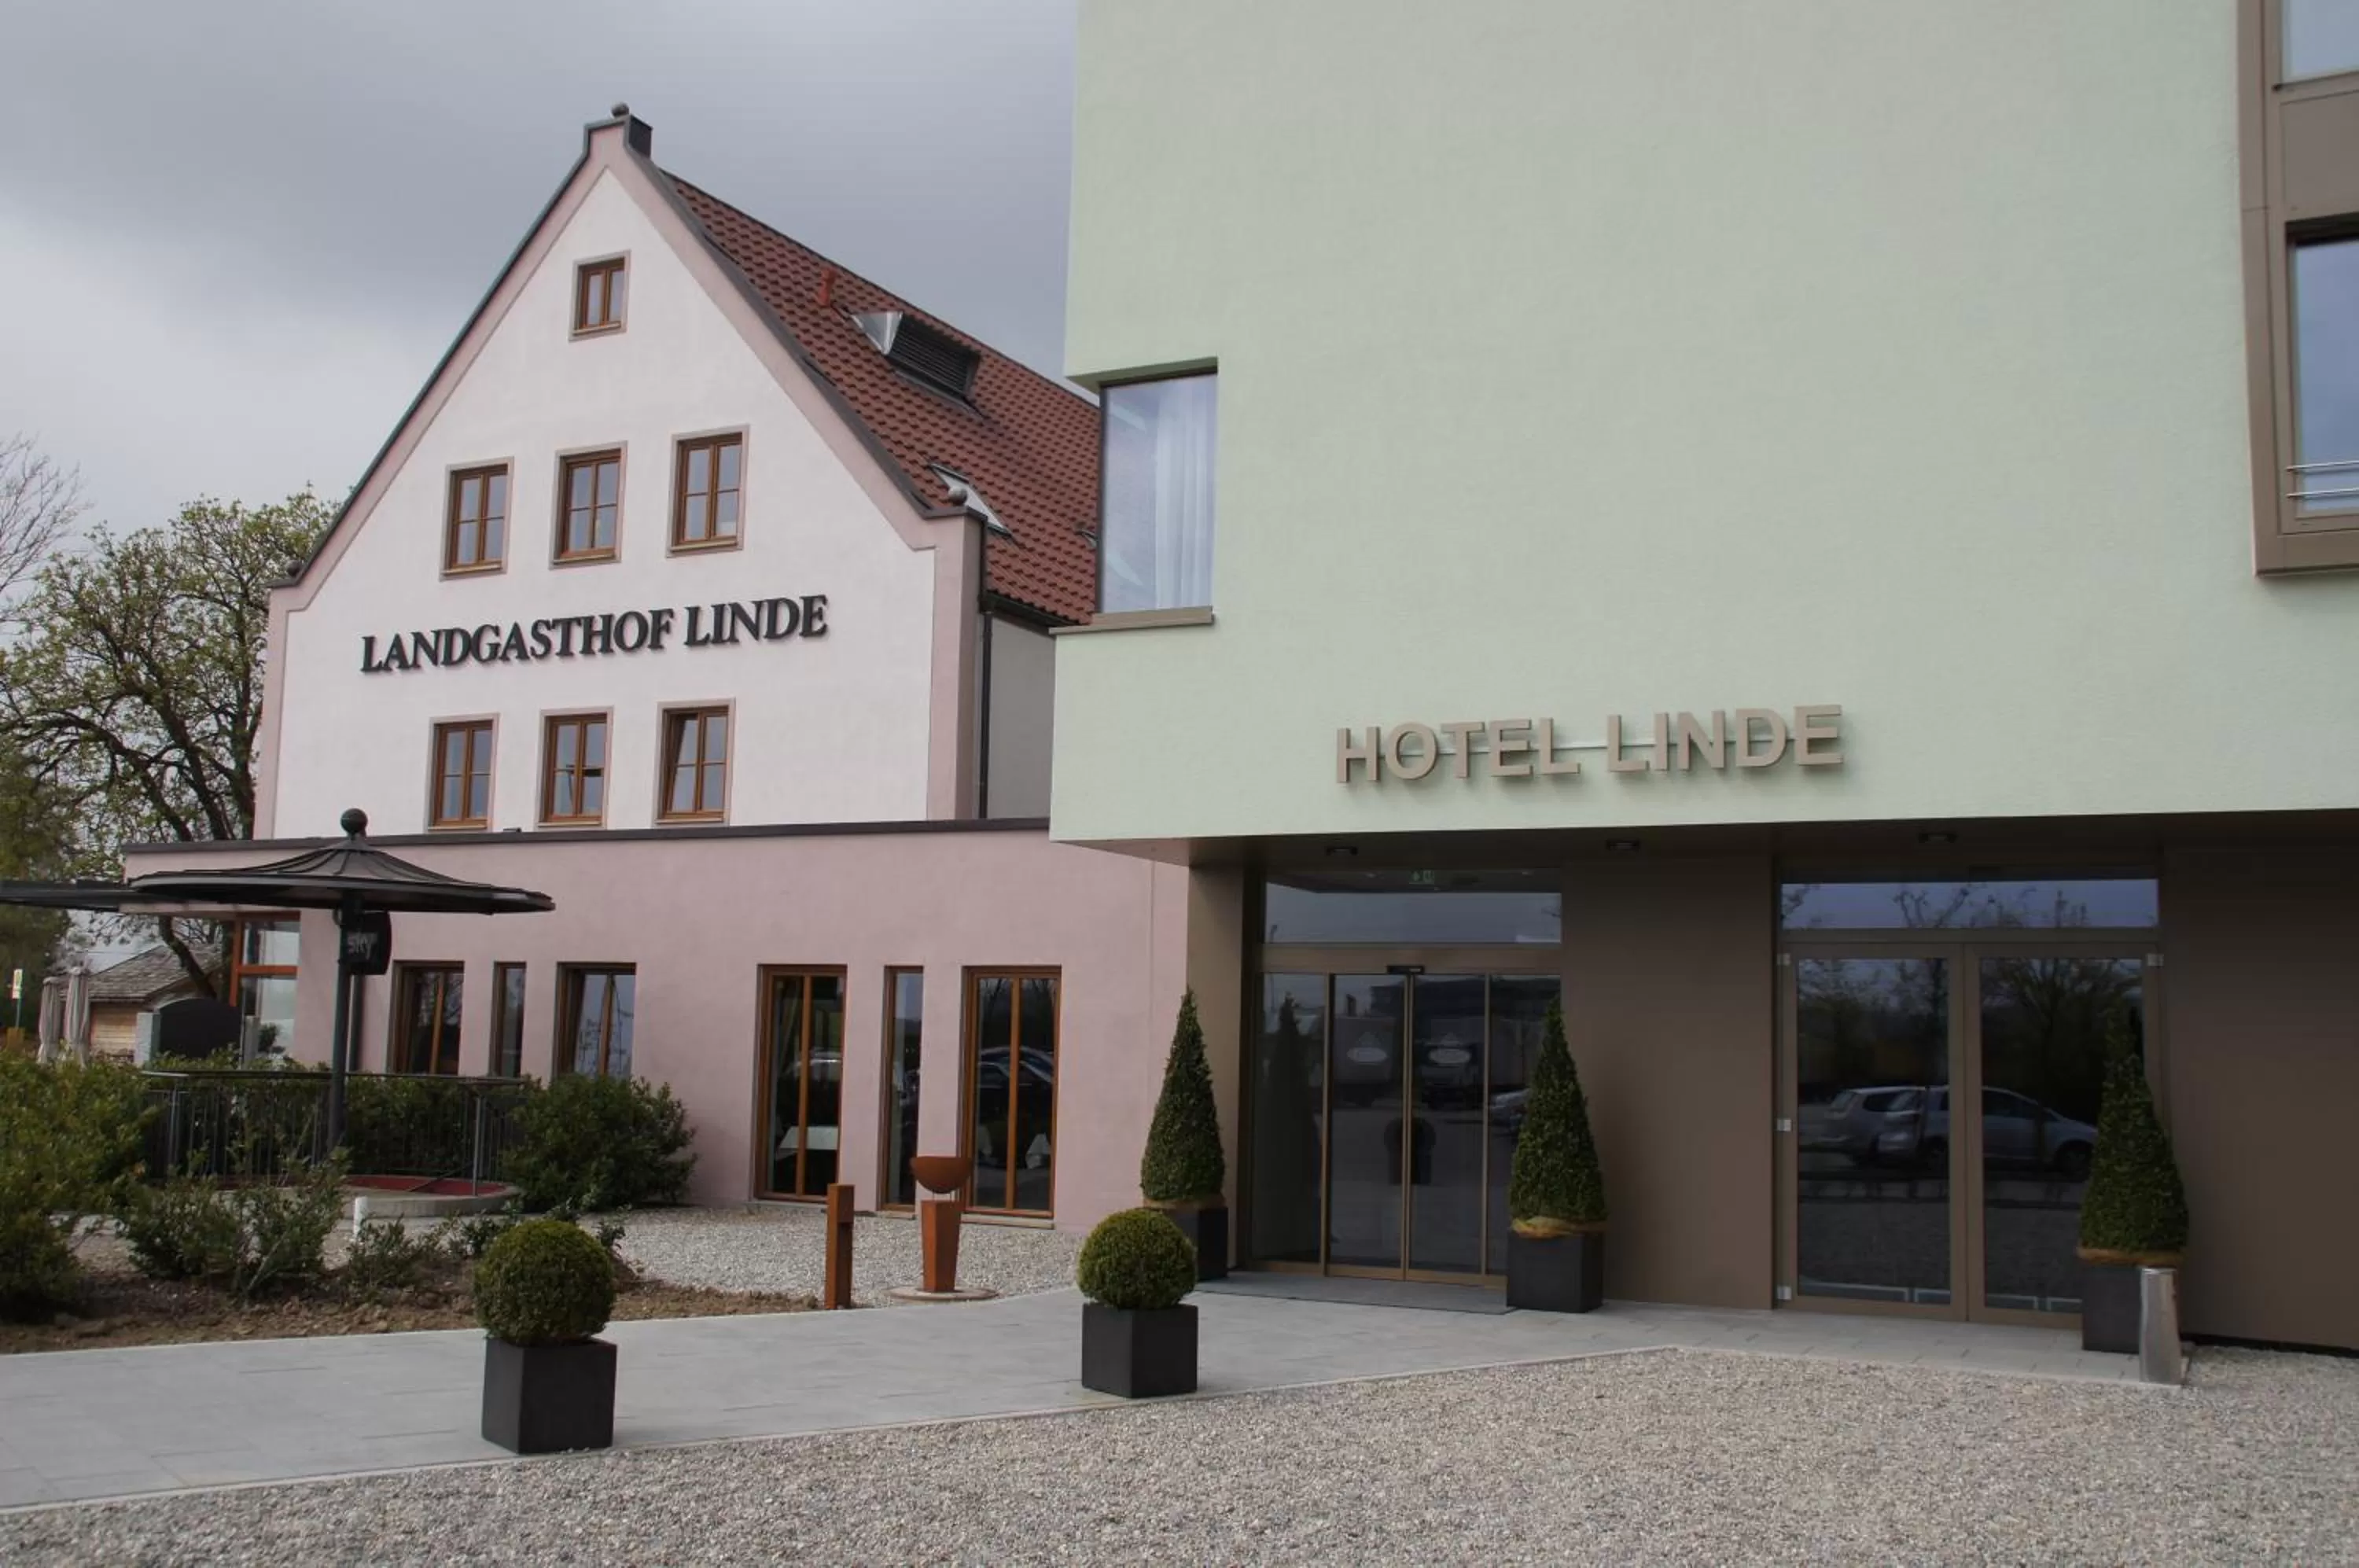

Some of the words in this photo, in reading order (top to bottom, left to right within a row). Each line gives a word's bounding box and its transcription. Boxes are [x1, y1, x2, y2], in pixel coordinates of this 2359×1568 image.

[361, 609, 674, 673] LANDGASTHOF
[684, 594, 828, 646] LINDE
[1338, 716, 1581, 783] HOTEL
[1608, 705, 1843, 772] LINDE
